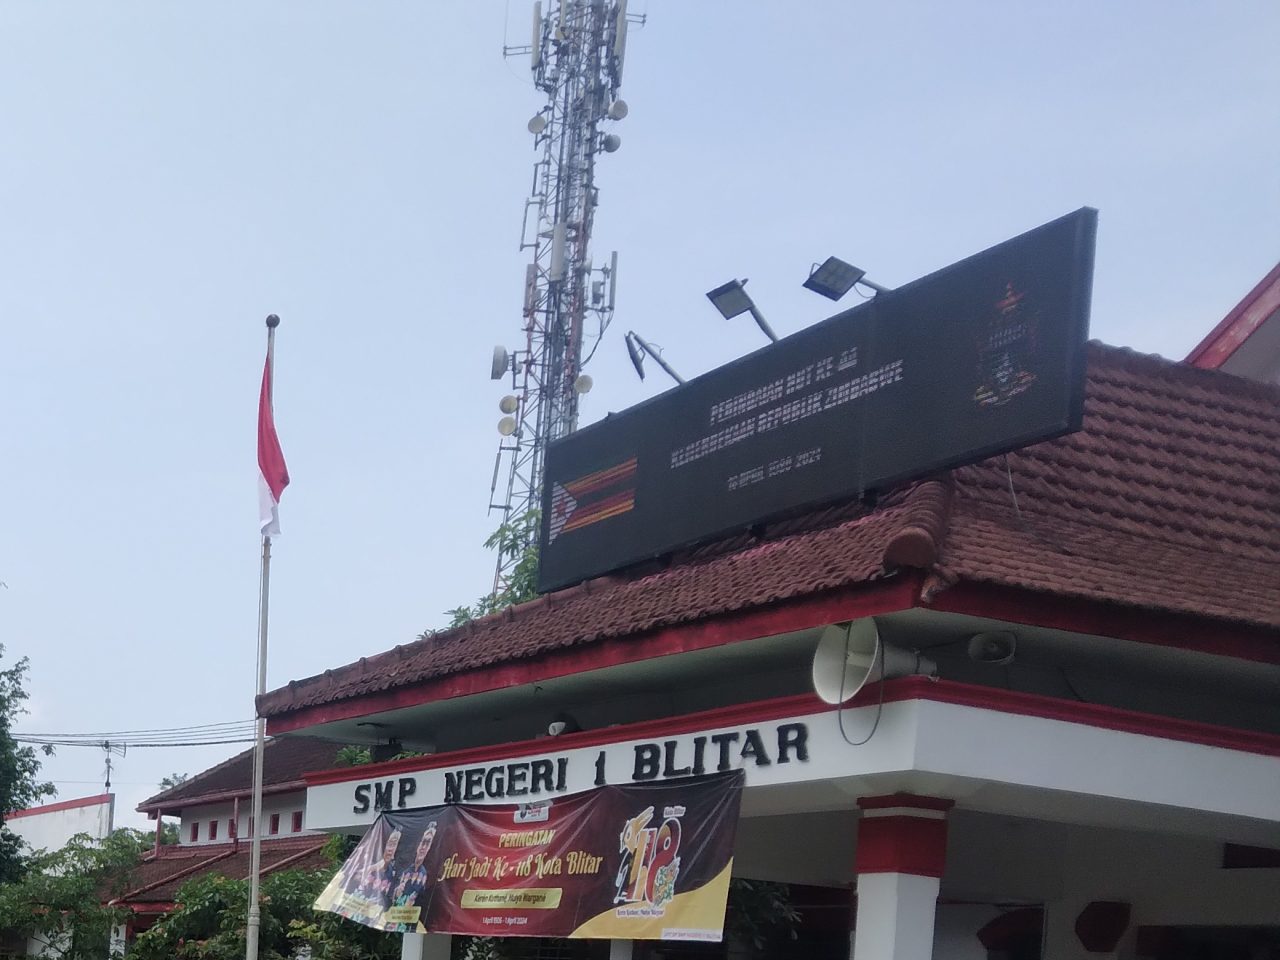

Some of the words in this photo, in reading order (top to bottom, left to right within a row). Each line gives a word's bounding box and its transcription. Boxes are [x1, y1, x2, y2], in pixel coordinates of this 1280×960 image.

[353, 777, 417, 814] SMP
[444, 757, 569, 804] NEGERI
[594, 751, 607, 786] 1
[631, 722, 810, 781] BLITAR
[498, 829, 556, 848] PERINGATAN
[438, 853, 468, 882] Hari
[465, 855, 492, 882] Jadi
[535, 852, 562, 880] Kota
[566, 850, 603, 876] Blitar
